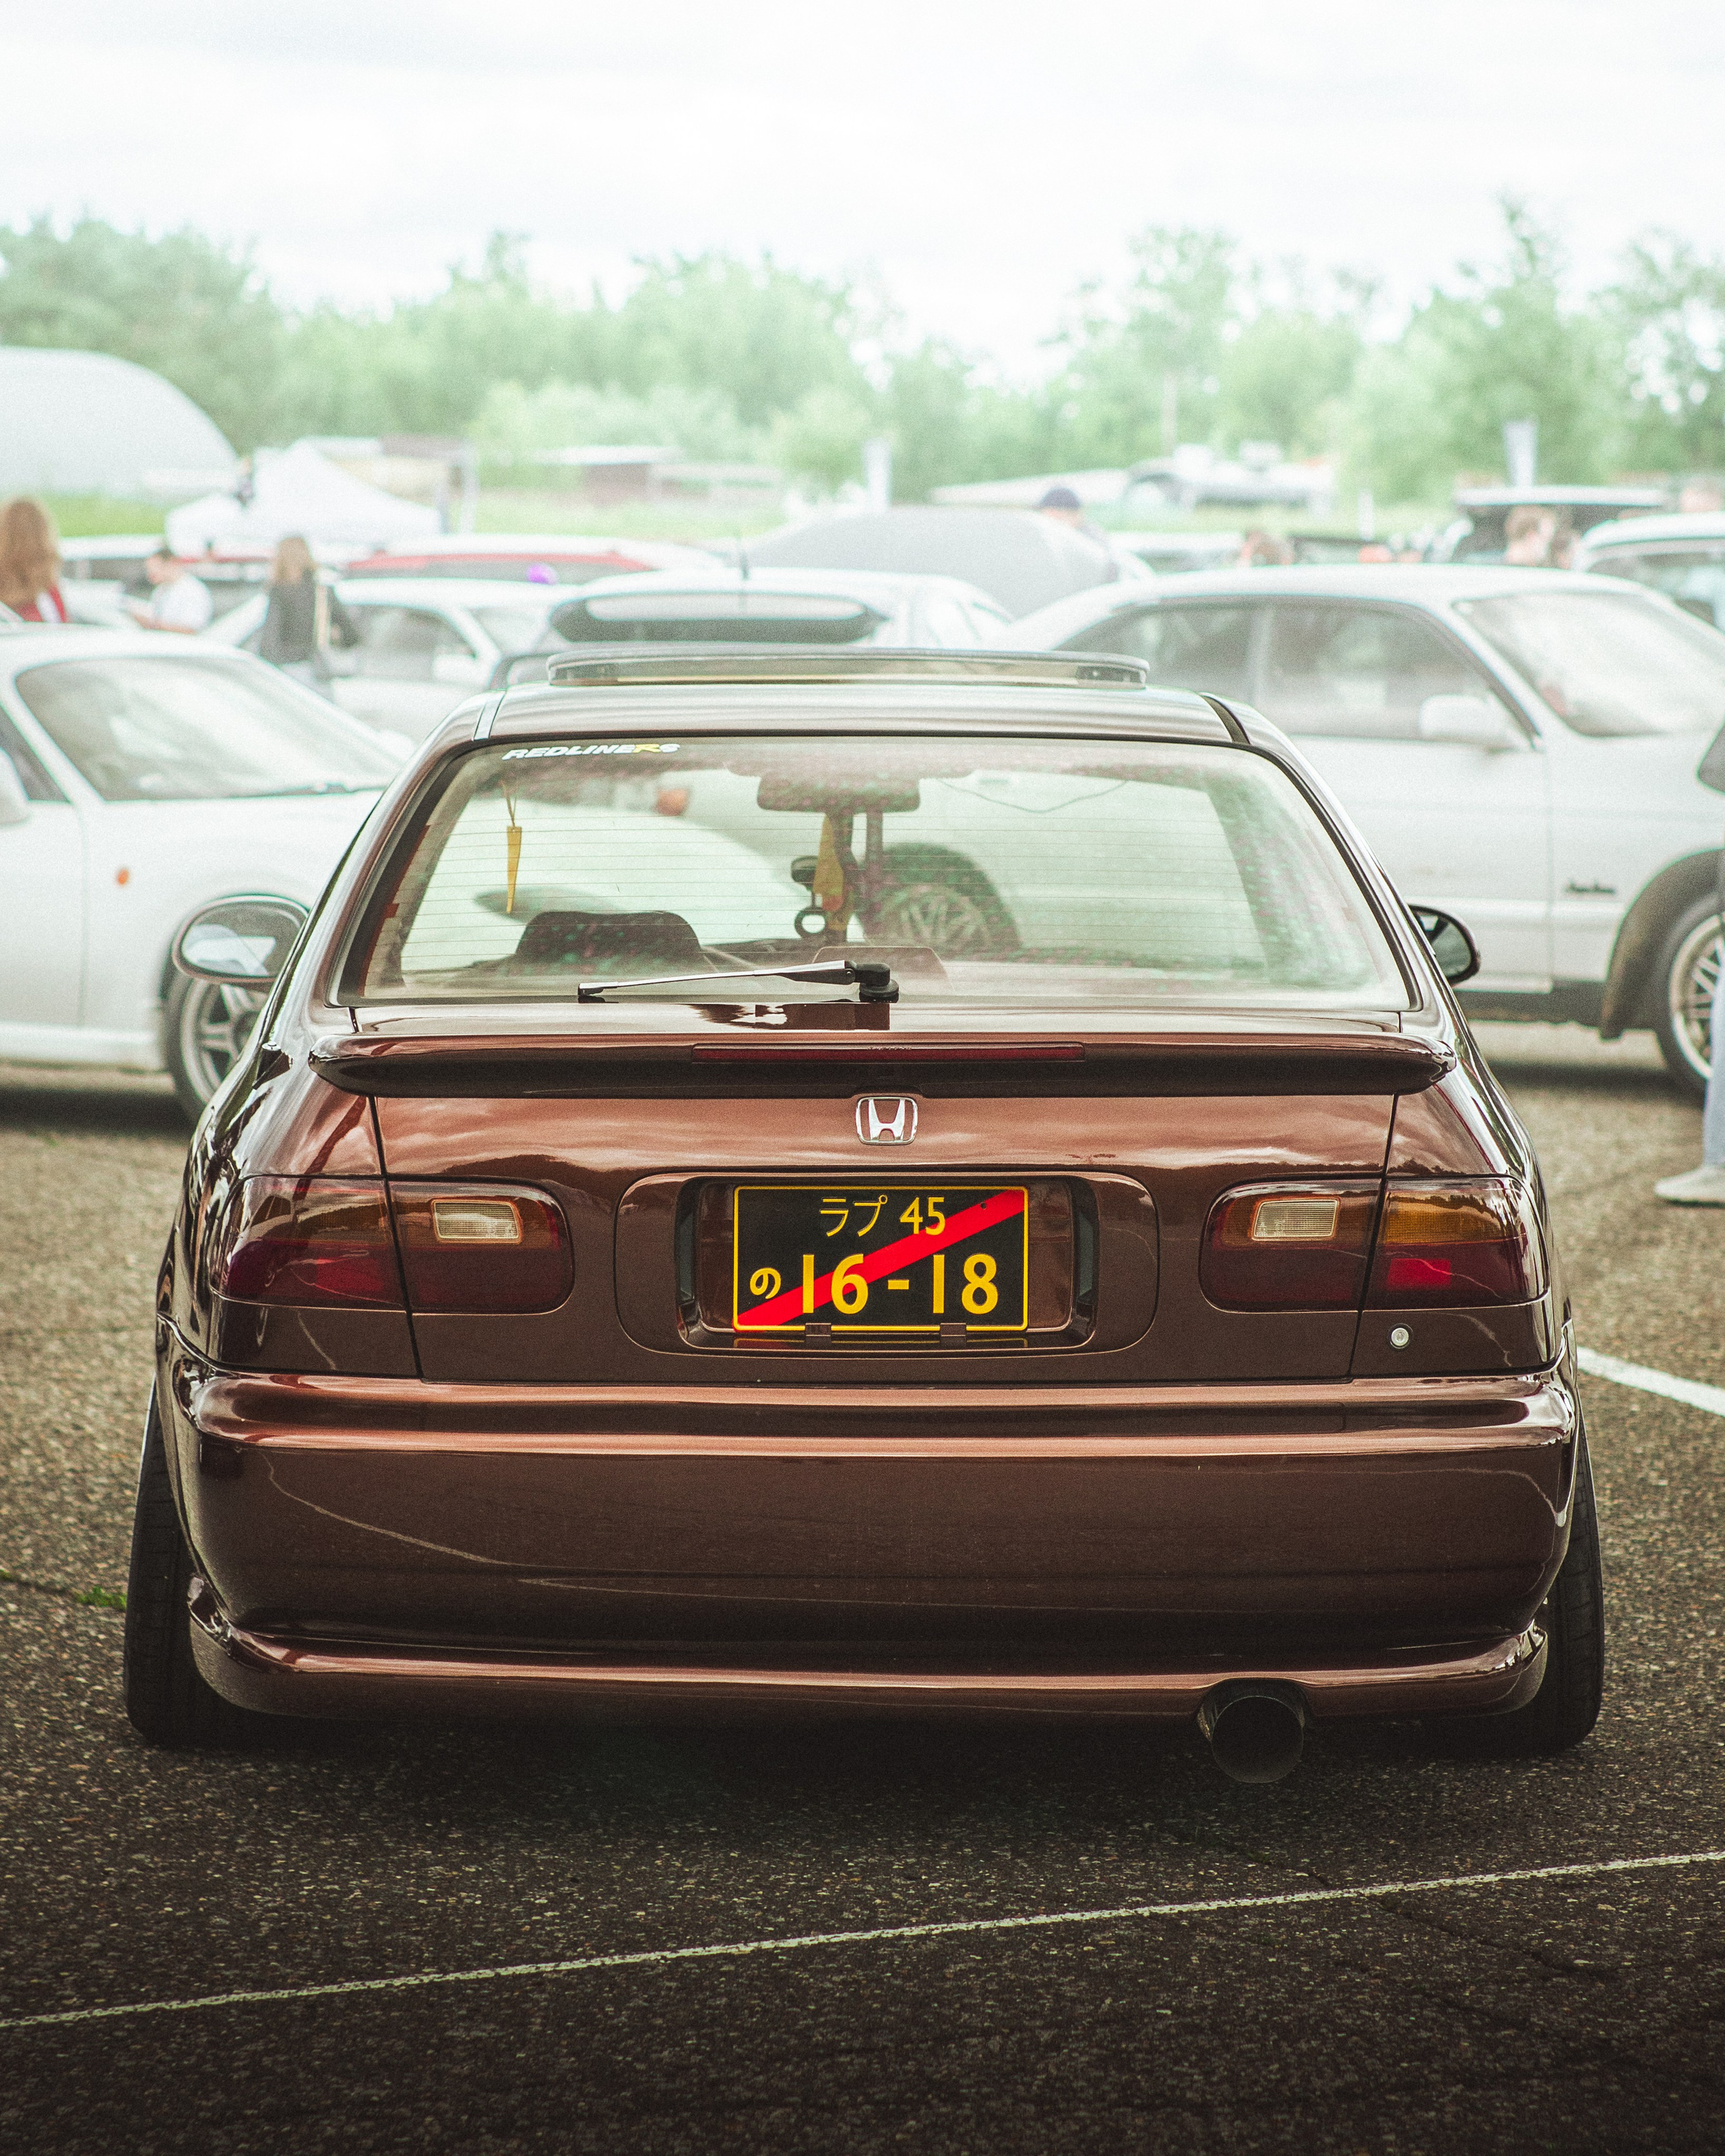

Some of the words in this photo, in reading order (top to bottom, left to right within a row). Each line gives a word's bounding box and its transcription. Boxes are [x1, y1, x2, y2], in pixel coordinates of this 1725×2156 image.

[501, 743, 681, 761] REDLINERS
[819, 1195, 888, 1237] ラプ
[900, 1197, 947, 1236] 45
[749, 1267, 782, 1300] の
[802, 1253, 999, 1315] 16-18
